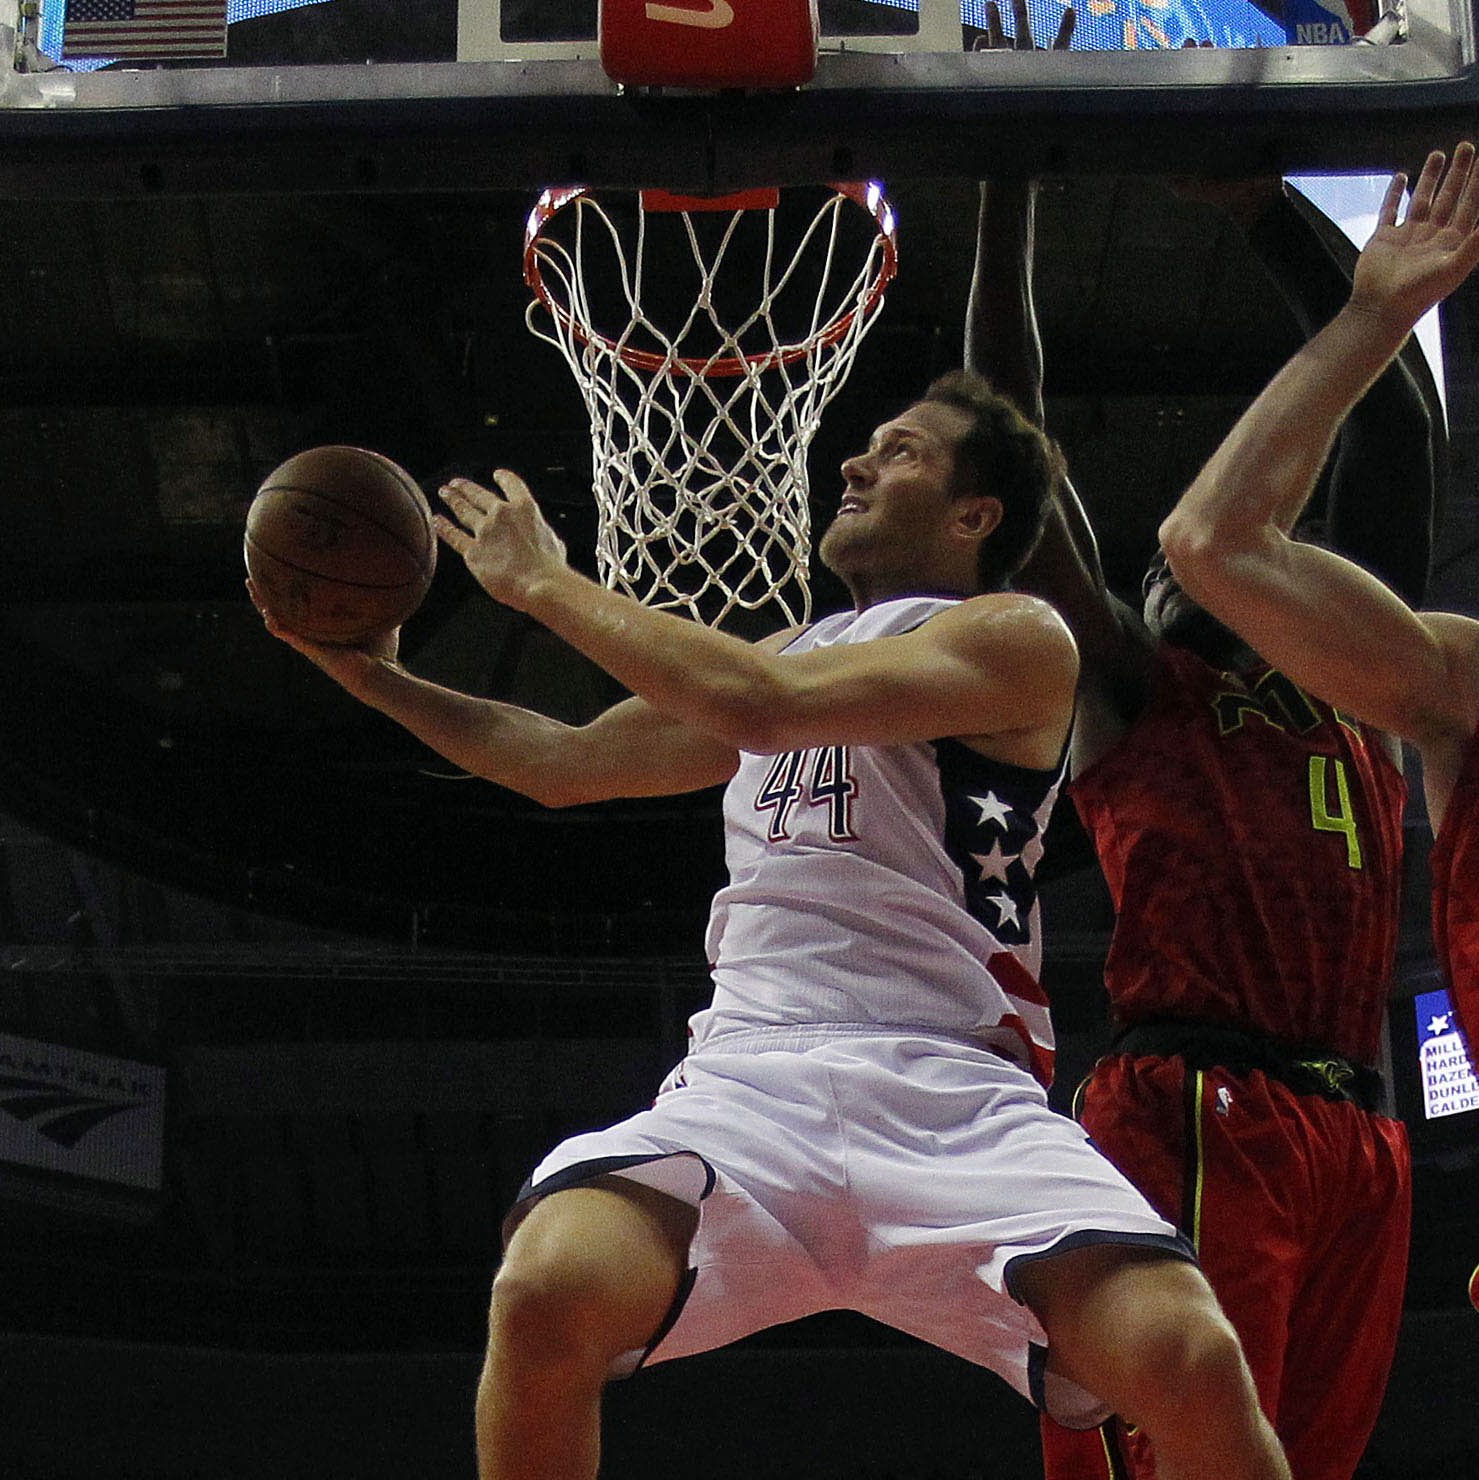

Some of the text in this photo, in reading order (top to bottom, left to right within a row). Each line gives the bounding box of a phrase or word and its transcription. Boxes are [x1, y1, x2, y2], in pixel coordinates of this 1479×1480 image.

[1296, 23, 1346, 45] NBA
[754, 745, 860, 843] 44
[1309, 755, 1362, 869] 4
